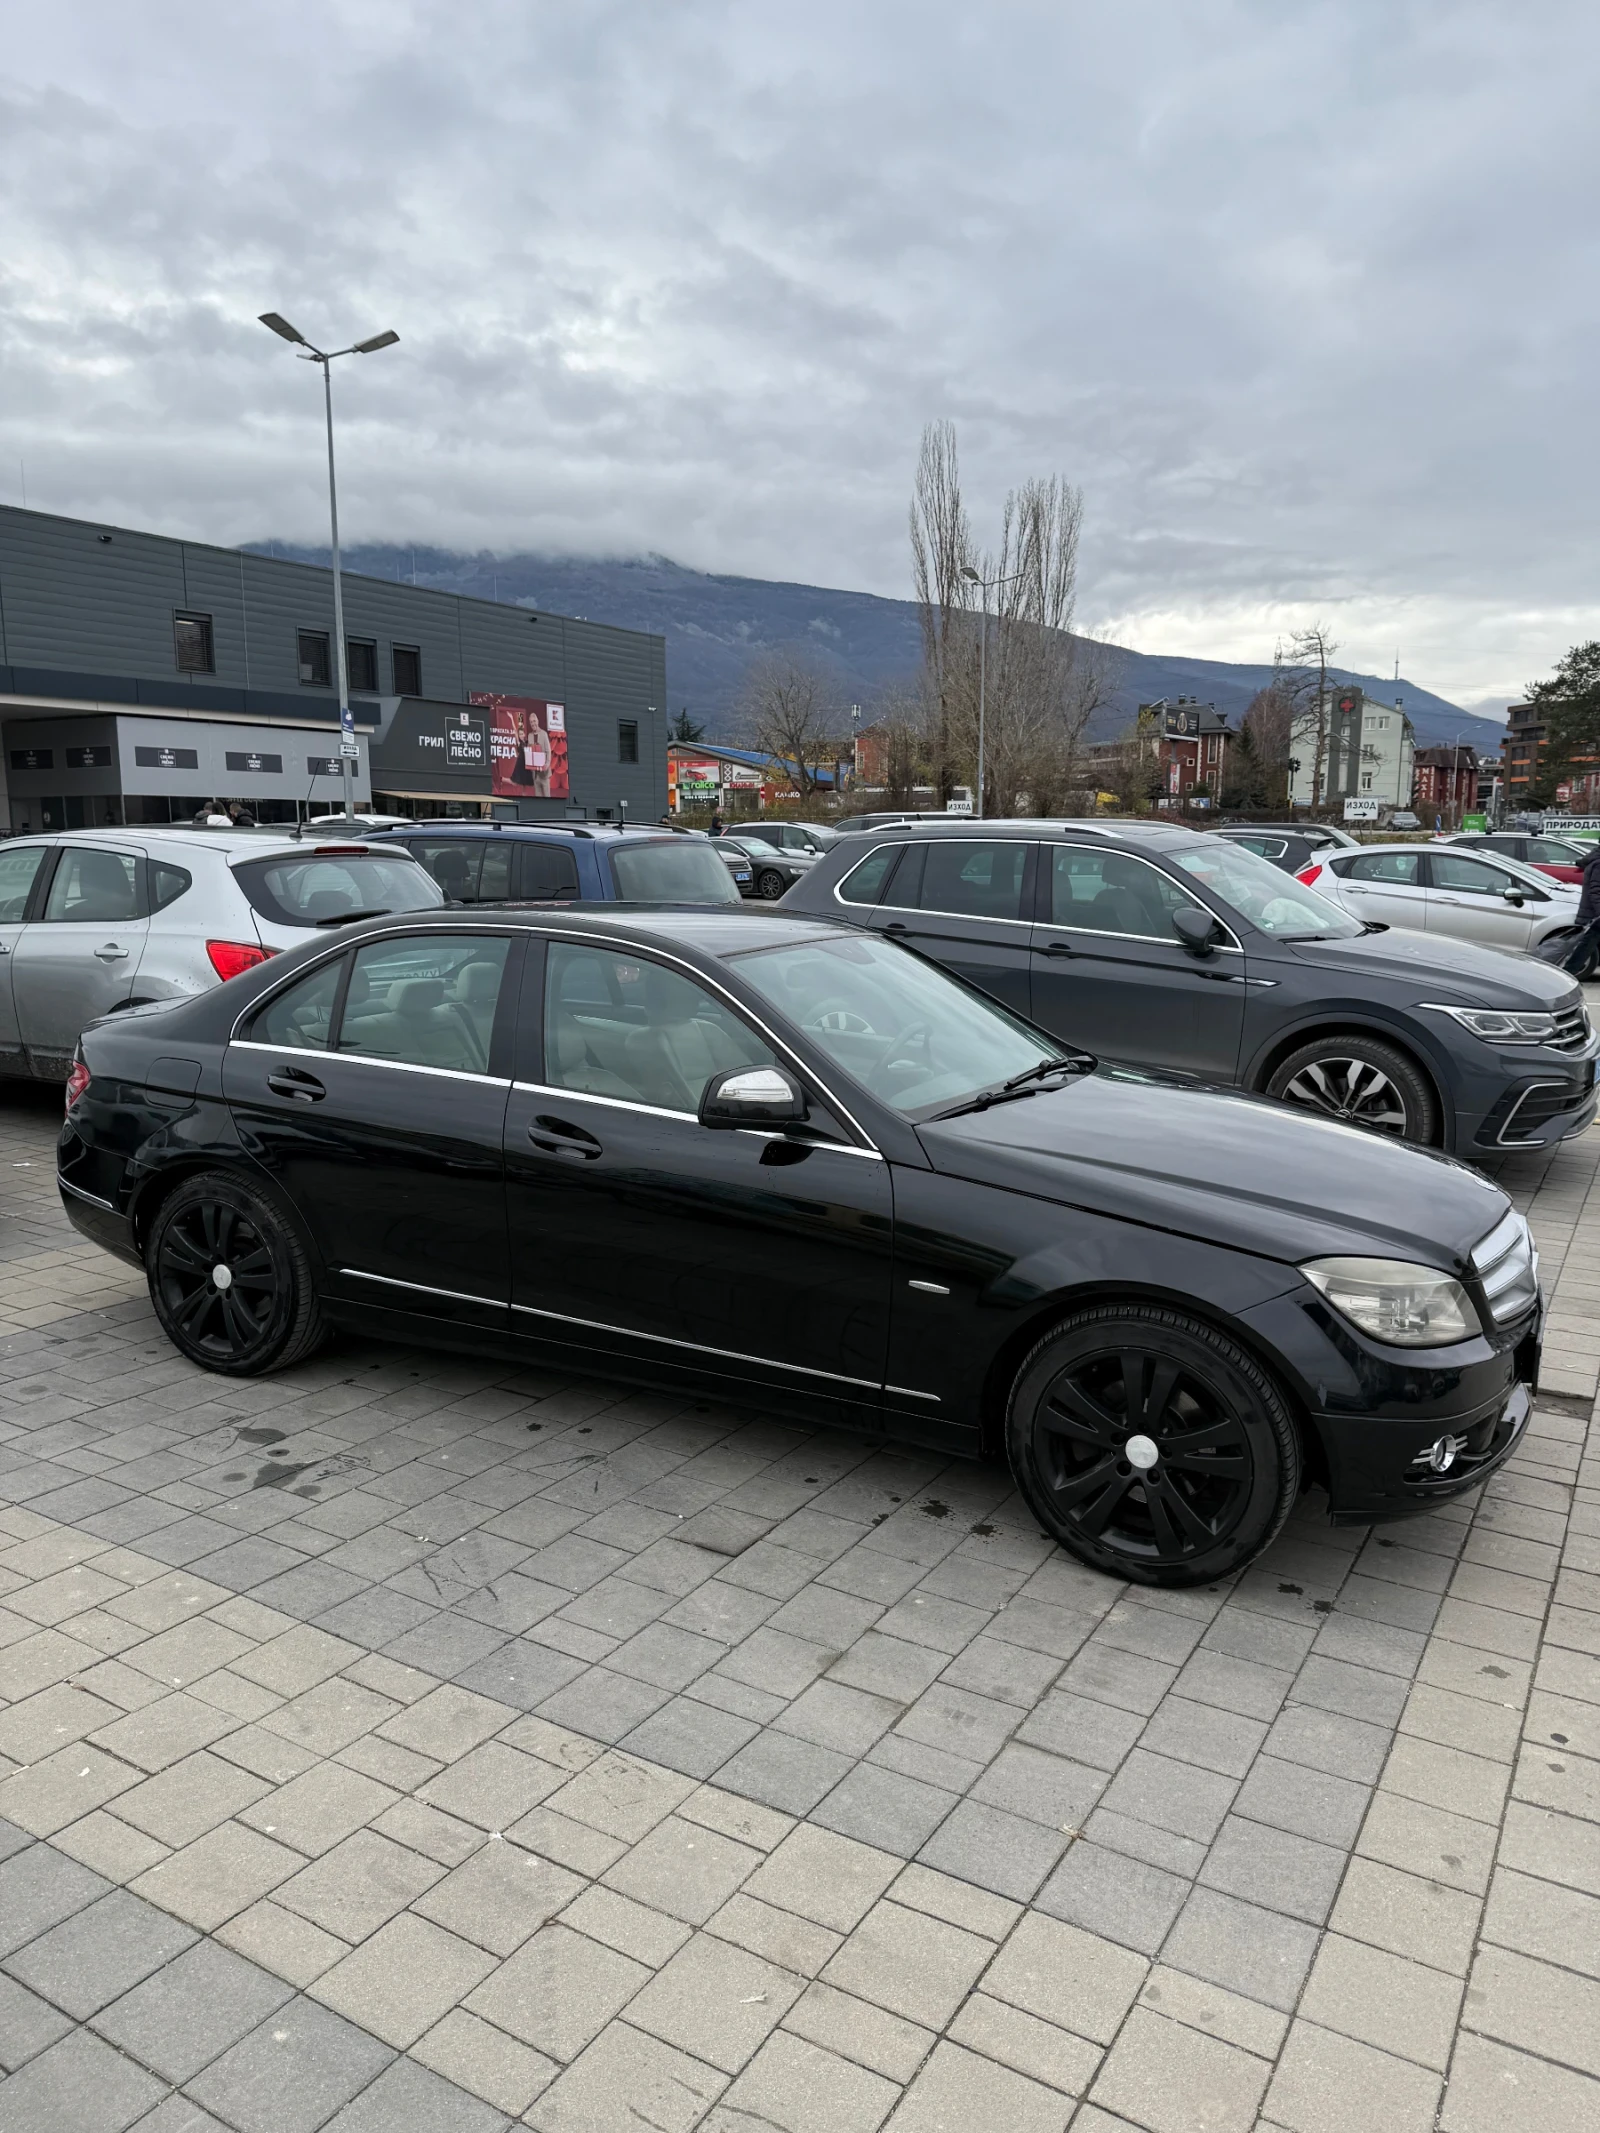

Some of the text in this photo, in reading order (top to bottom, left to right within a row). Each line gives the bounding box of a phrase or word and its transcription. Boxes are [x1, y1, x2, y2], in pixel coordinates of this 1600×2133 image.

[419, 735, 444, 748] ГРИЛ
[449, 730, 481, 742] СВЕЖО
[451, 746, 481, 758] ЛЕСНО
[1346, 801, 1376, 810] ИЗХОД
